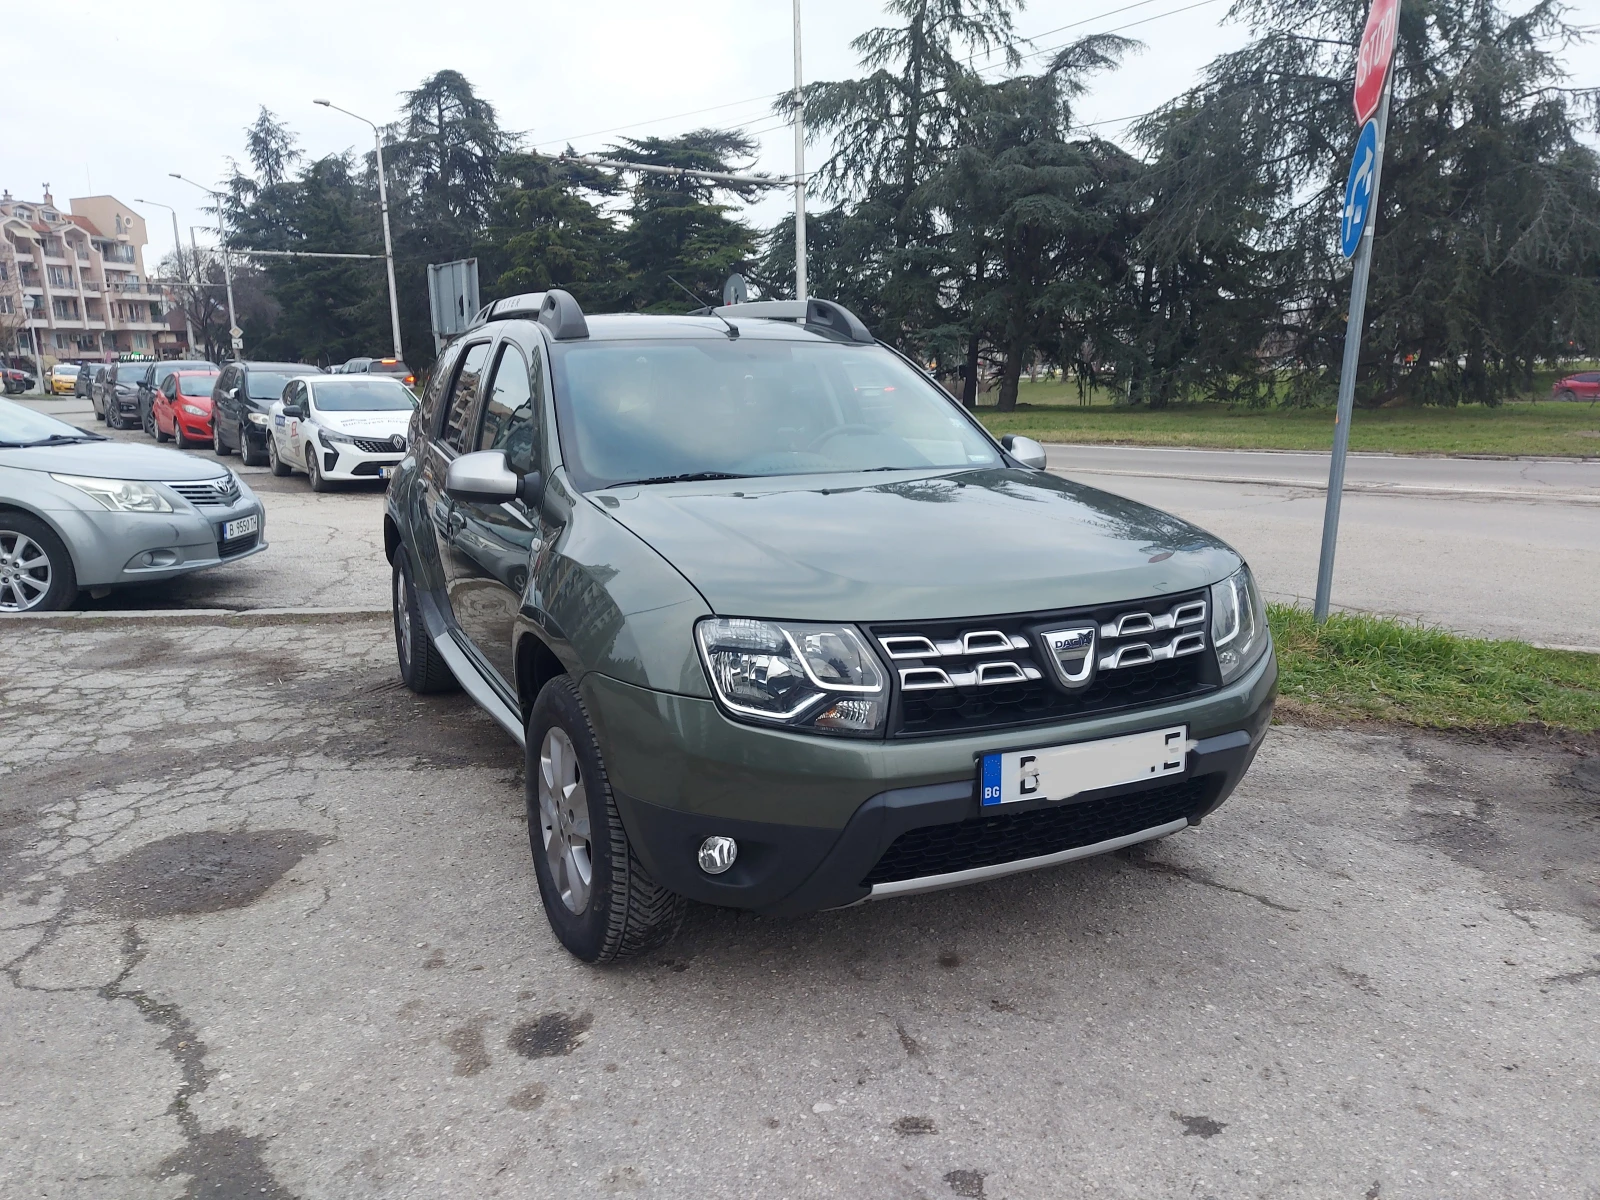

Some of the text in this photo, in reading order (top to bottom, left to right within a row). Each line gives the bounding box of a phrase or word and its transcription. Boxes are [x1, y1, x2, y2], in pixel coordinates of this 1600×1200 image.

[1358, 6, 1393, 88] STOP
[229, 523, 235, 537] B
[1055, 637, 1090, 650] DACIA
[984, 786, 1000, 800] BG
